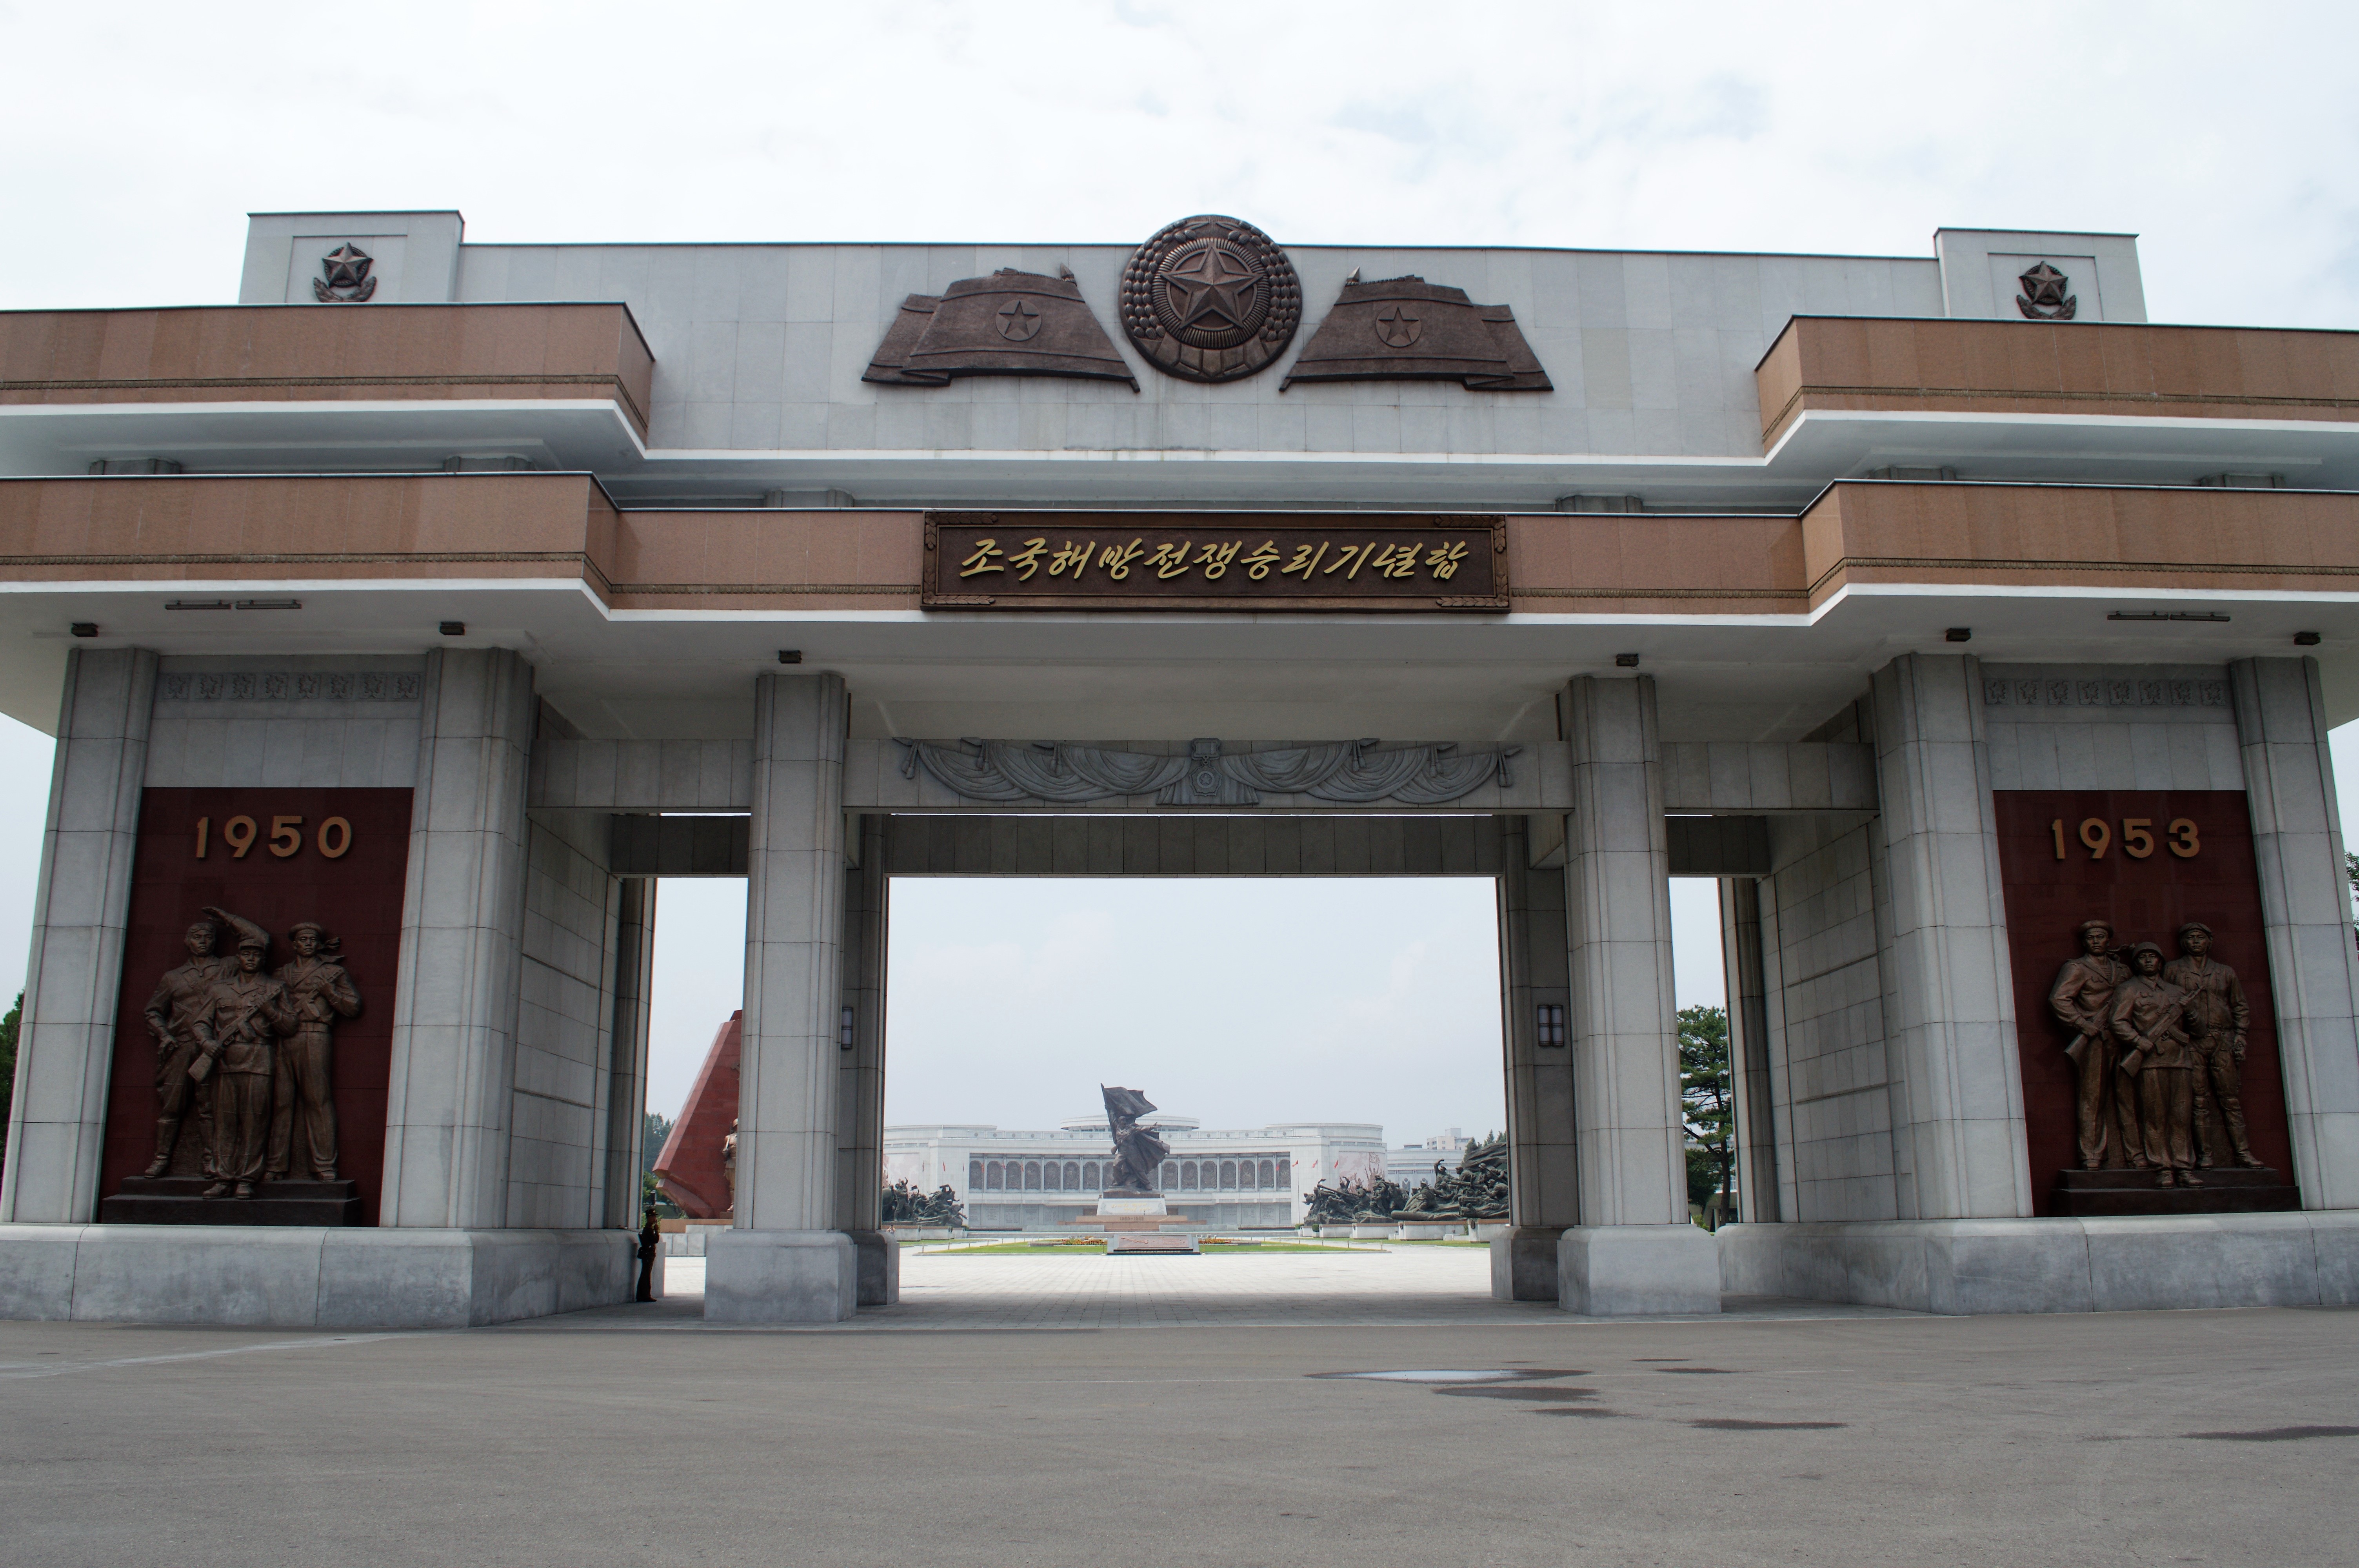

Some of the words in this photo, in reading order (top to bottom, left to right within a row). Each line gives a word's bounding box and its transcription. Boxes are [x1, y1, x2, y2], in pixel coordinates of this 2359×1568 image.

[960, 537, 1469, 581] 조국해방전쟁승리기념탑
[196, 815, 352, 858] 1950
[2052, 818, 2200, 859] 1953
